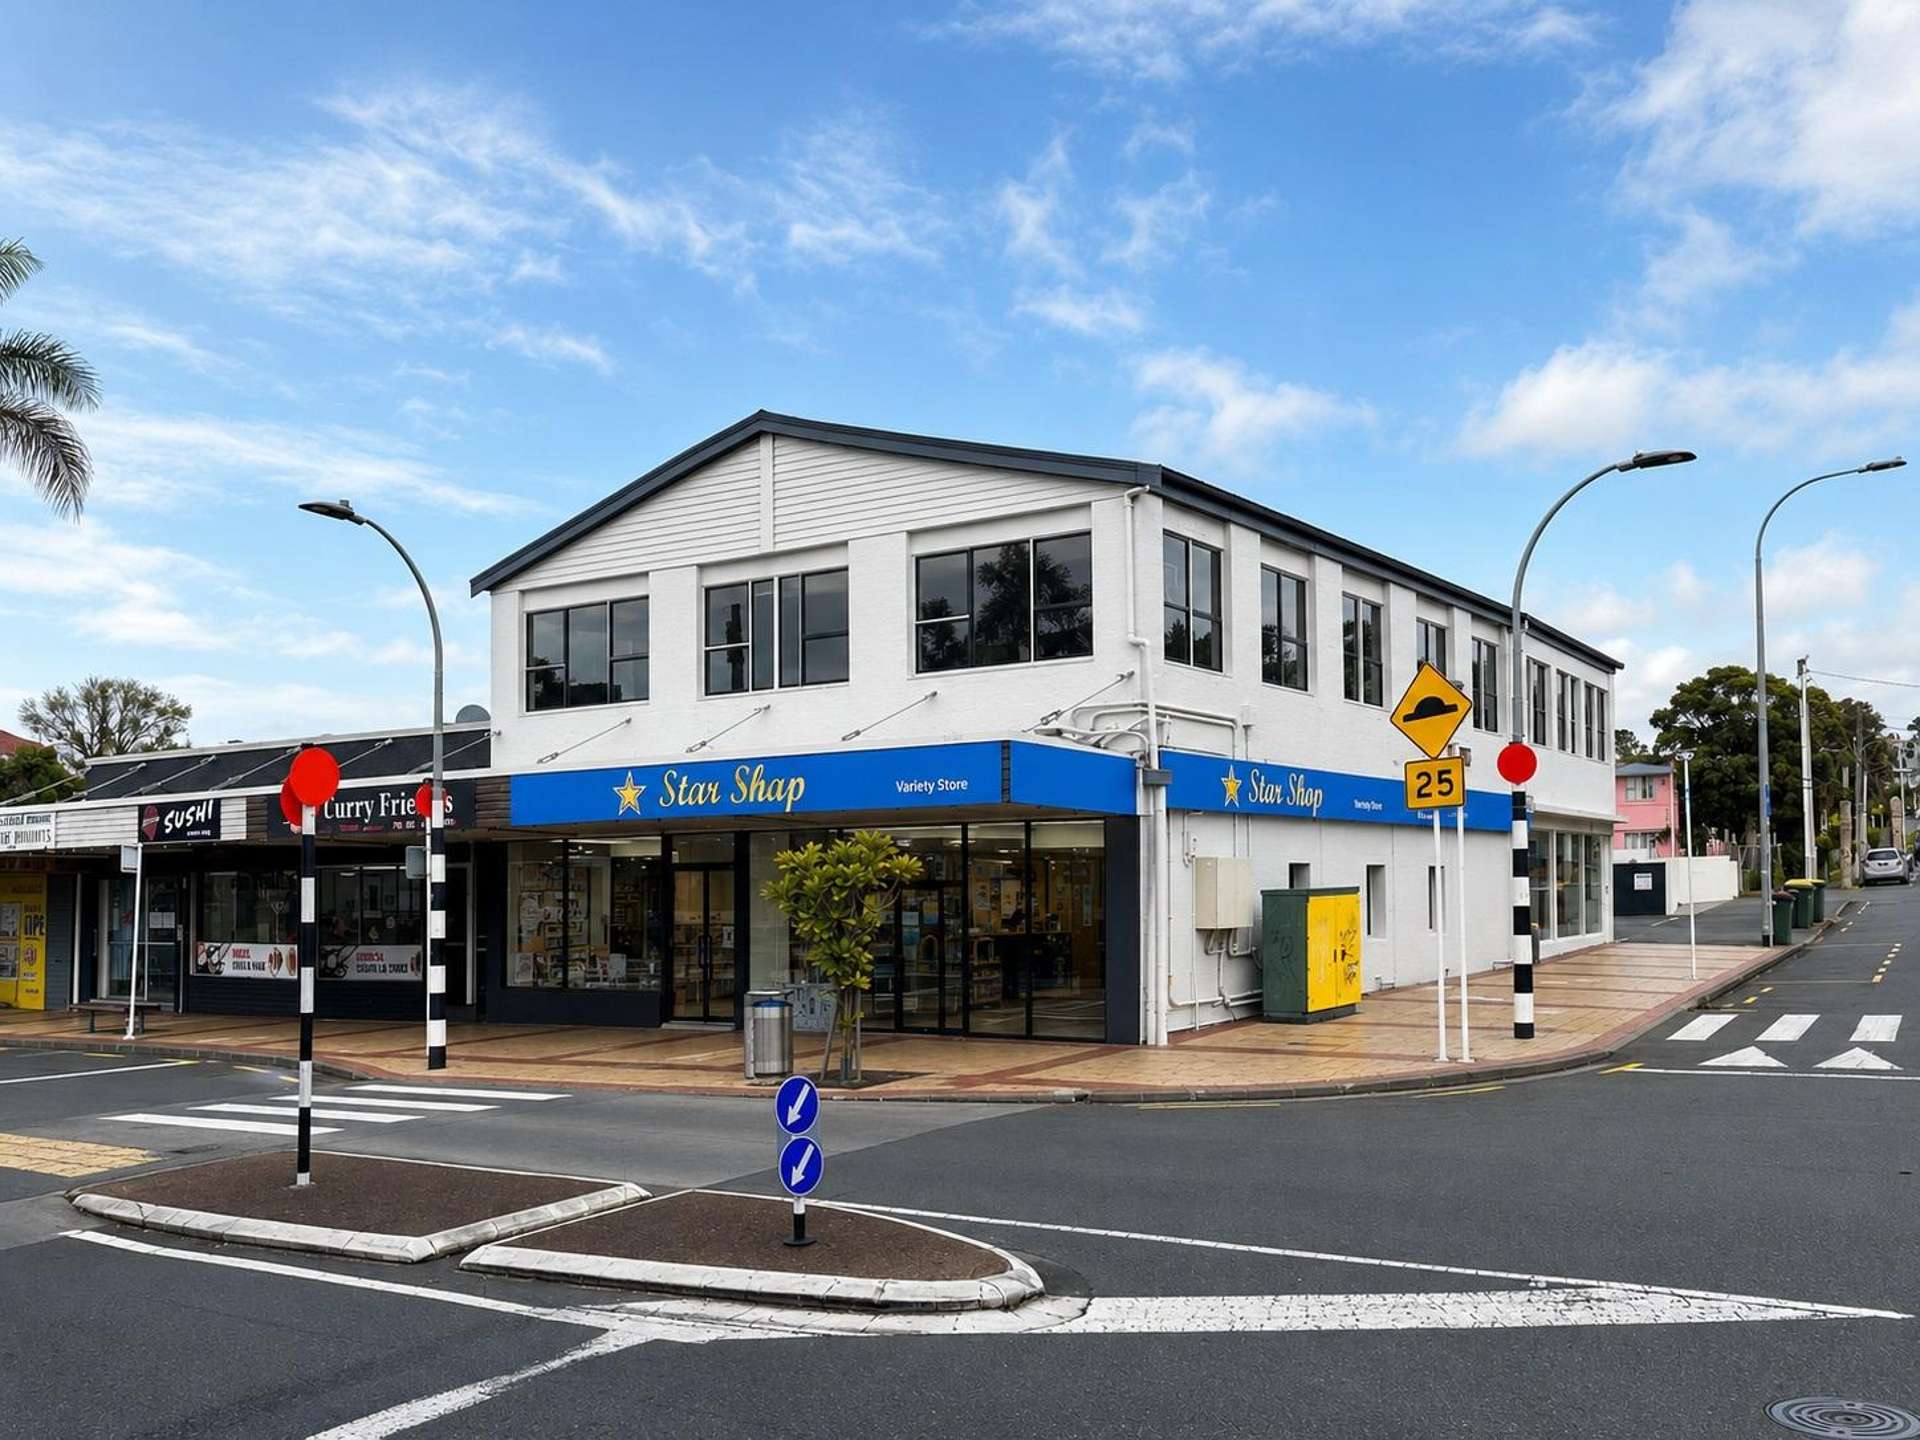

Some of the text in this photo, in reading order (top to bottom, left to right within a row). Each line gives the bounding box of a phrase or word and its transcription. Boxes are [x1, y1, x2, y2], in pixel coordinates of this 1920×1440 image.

[659, 769, 721, 808] Star
[895, 778, 968, 795] Variety Store
[1248, 768, 1323, 817] Star Shop
[1416, 768, 1454, 799] 25
[164, 799, 214, 834] SUSHI
[324, 791, 454, 823] Curry Fries
